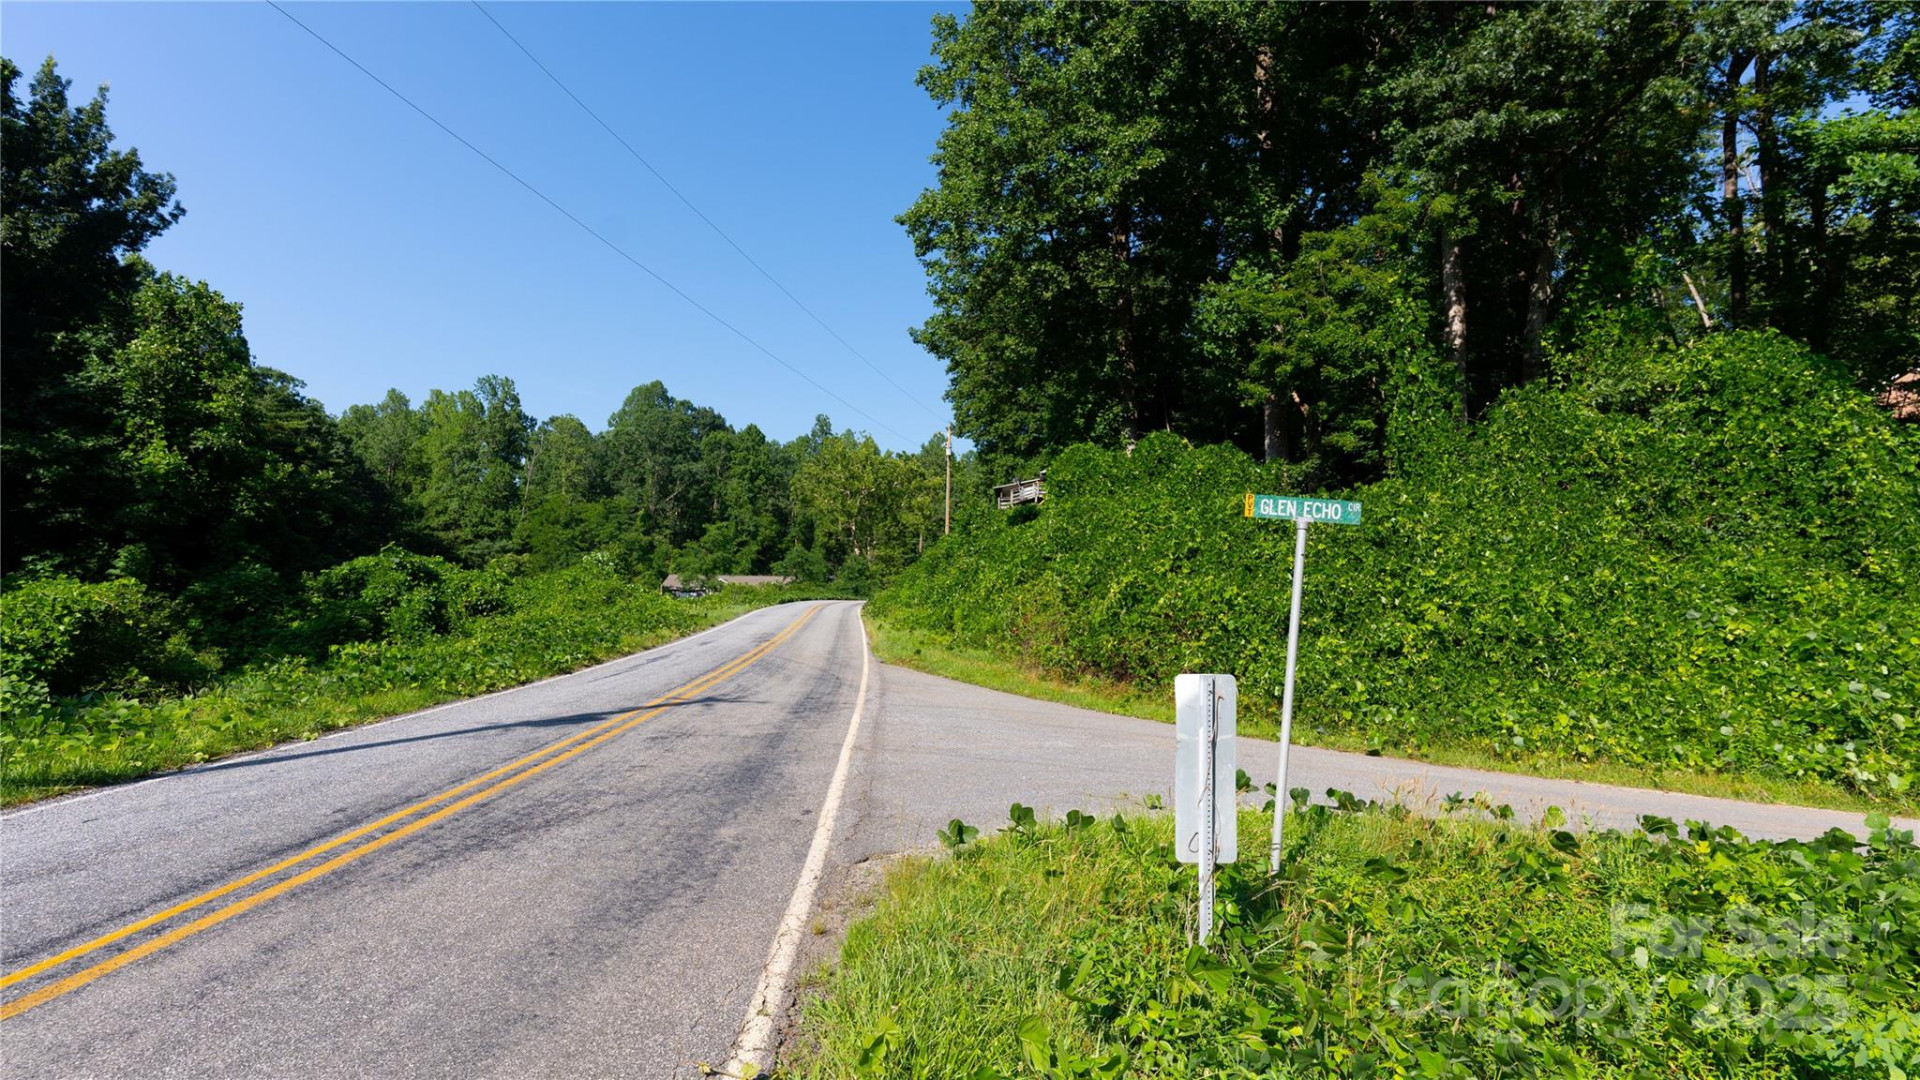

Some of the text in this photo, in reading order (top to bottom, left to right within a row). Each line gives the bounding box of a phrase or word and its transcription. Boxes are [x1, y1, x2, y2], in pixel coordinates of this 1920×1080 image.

[1260, 498, 1362, 520] GLEN ECHO CIR
